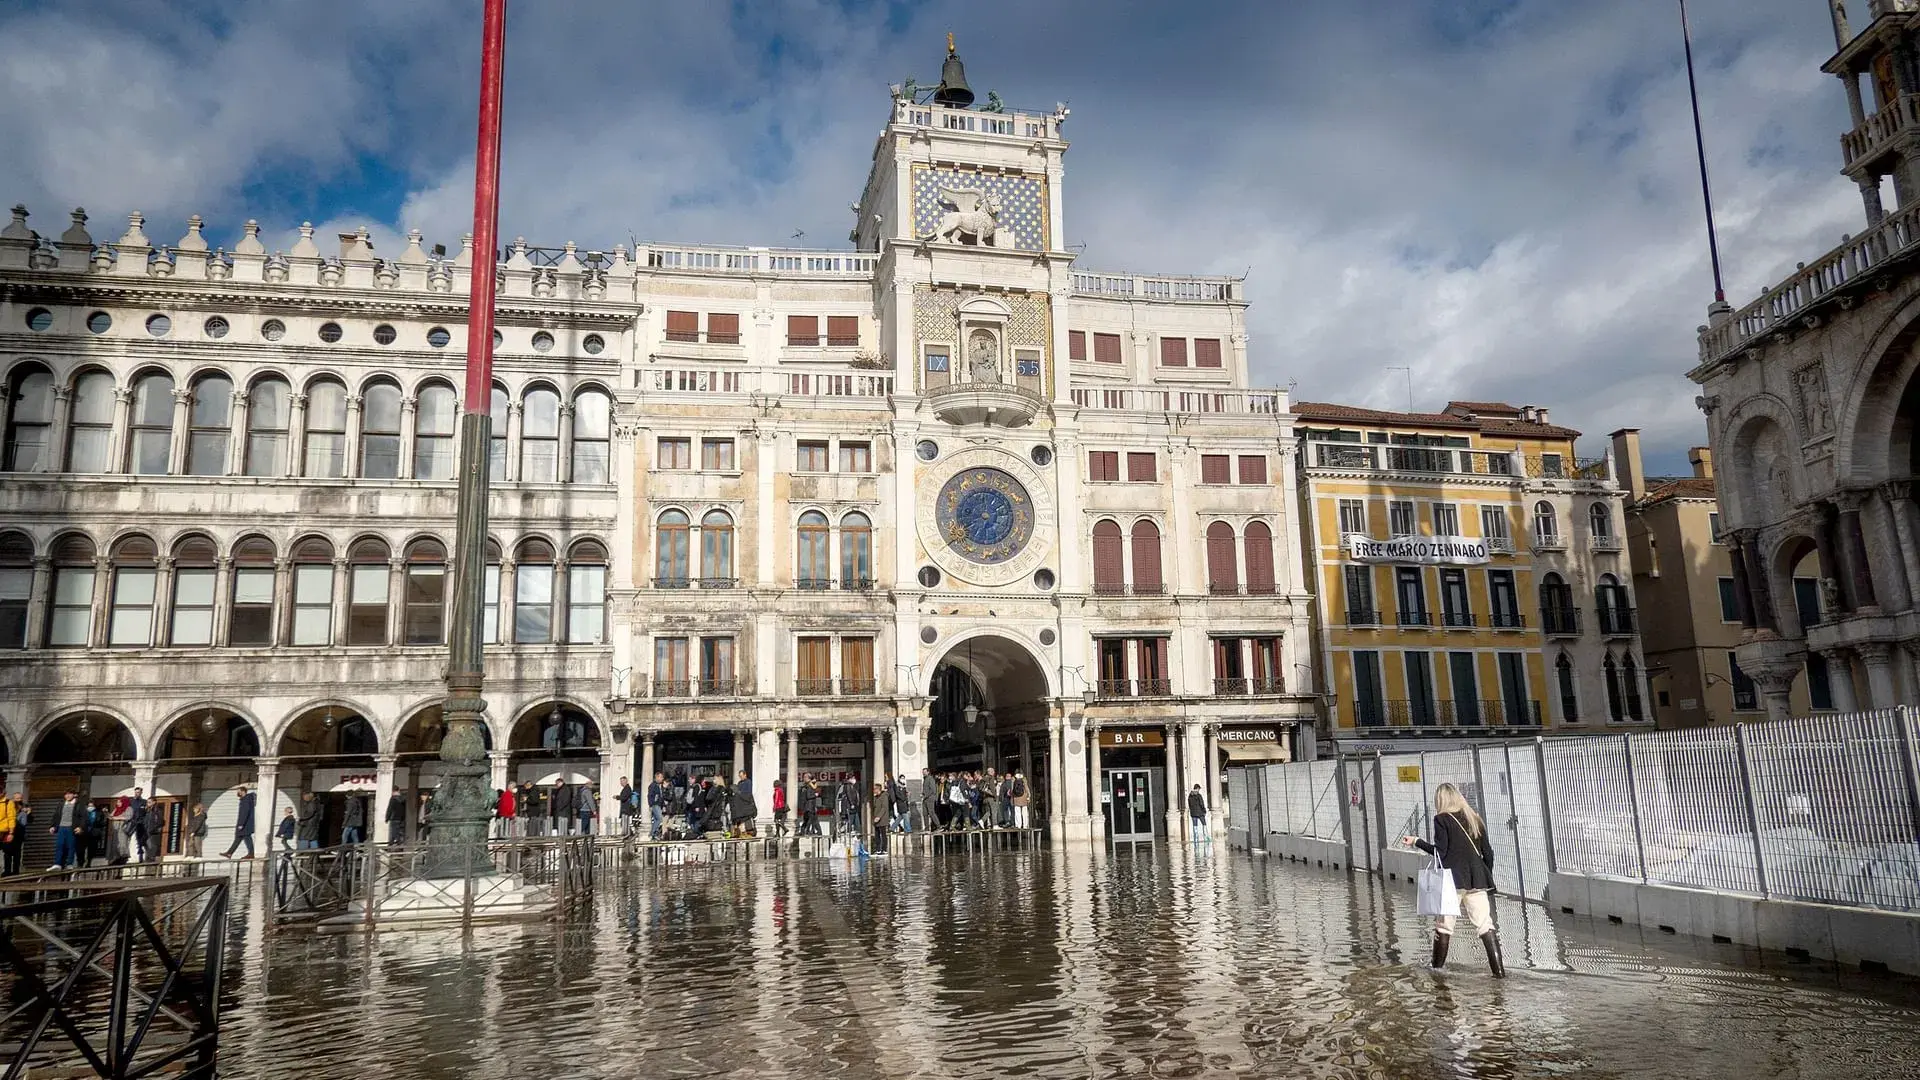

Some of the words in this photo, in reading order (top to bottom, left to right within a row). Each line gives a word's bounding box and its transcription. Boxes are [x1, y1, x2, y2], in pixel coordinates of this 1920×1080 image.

[1355, 543, 1386, 557] FREE
[1386, 543, 1428, 557] MARCO
[1431, 543, 1485, 558] ZENNARO
[1114, 733, 1145, 743] BAR
[1216, 730, 1276, 741] AMERICANO
[801, 746, 843, 755] CHANGE
